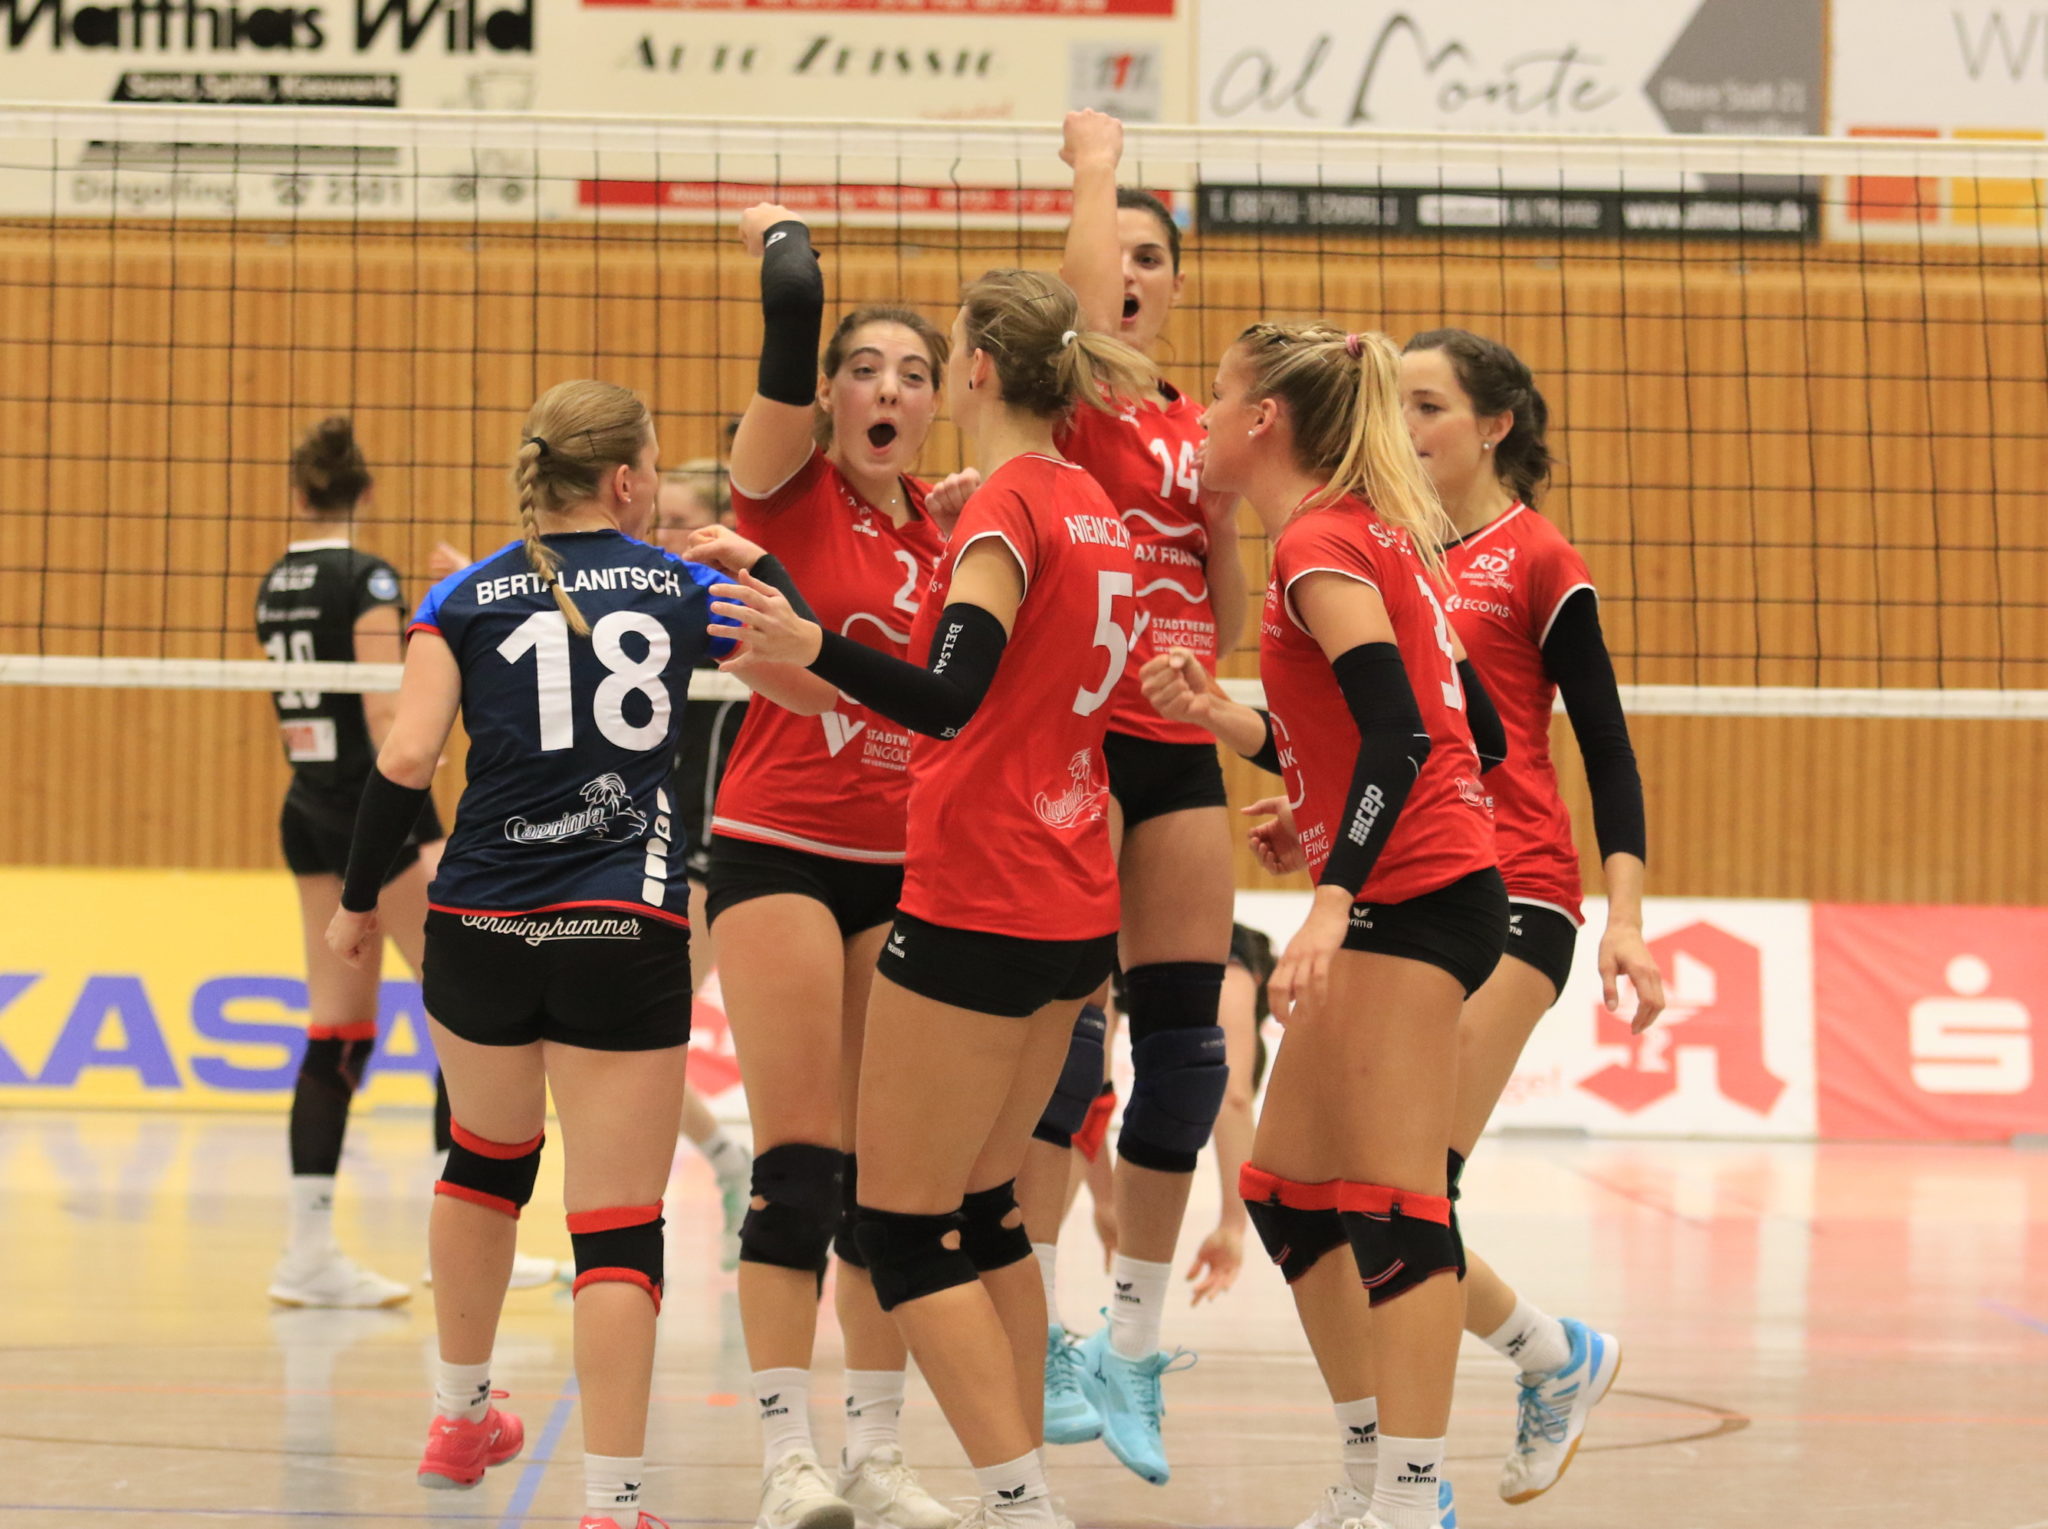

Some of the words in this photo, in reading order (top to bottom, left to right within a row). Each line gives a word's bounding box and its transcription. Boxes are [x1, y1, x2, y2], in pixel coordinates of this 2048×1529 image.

[1, 0, 324, 49] Matthias
[353, 0, 534, 53] Wild
[1343, 12, 1622, 127] Monte
[1148, 438, 1199, 505] 14
[1134, 544, 1158, 563] AX
[893, 549, 921, 614] 2
[1462, 598, 1510, 618] ECOVIS
[1072, 570, 1134, 717] 5
[496, 609, 672, 752] 18
[866, 728, 912, 748] STADTW
[1348, 917, 1374, 929] rima
[1346, 1434, 1378, 1446] erim
[1397, 1474, 1438, 1484] erima
[615, 1493, 639, 1503] eri
